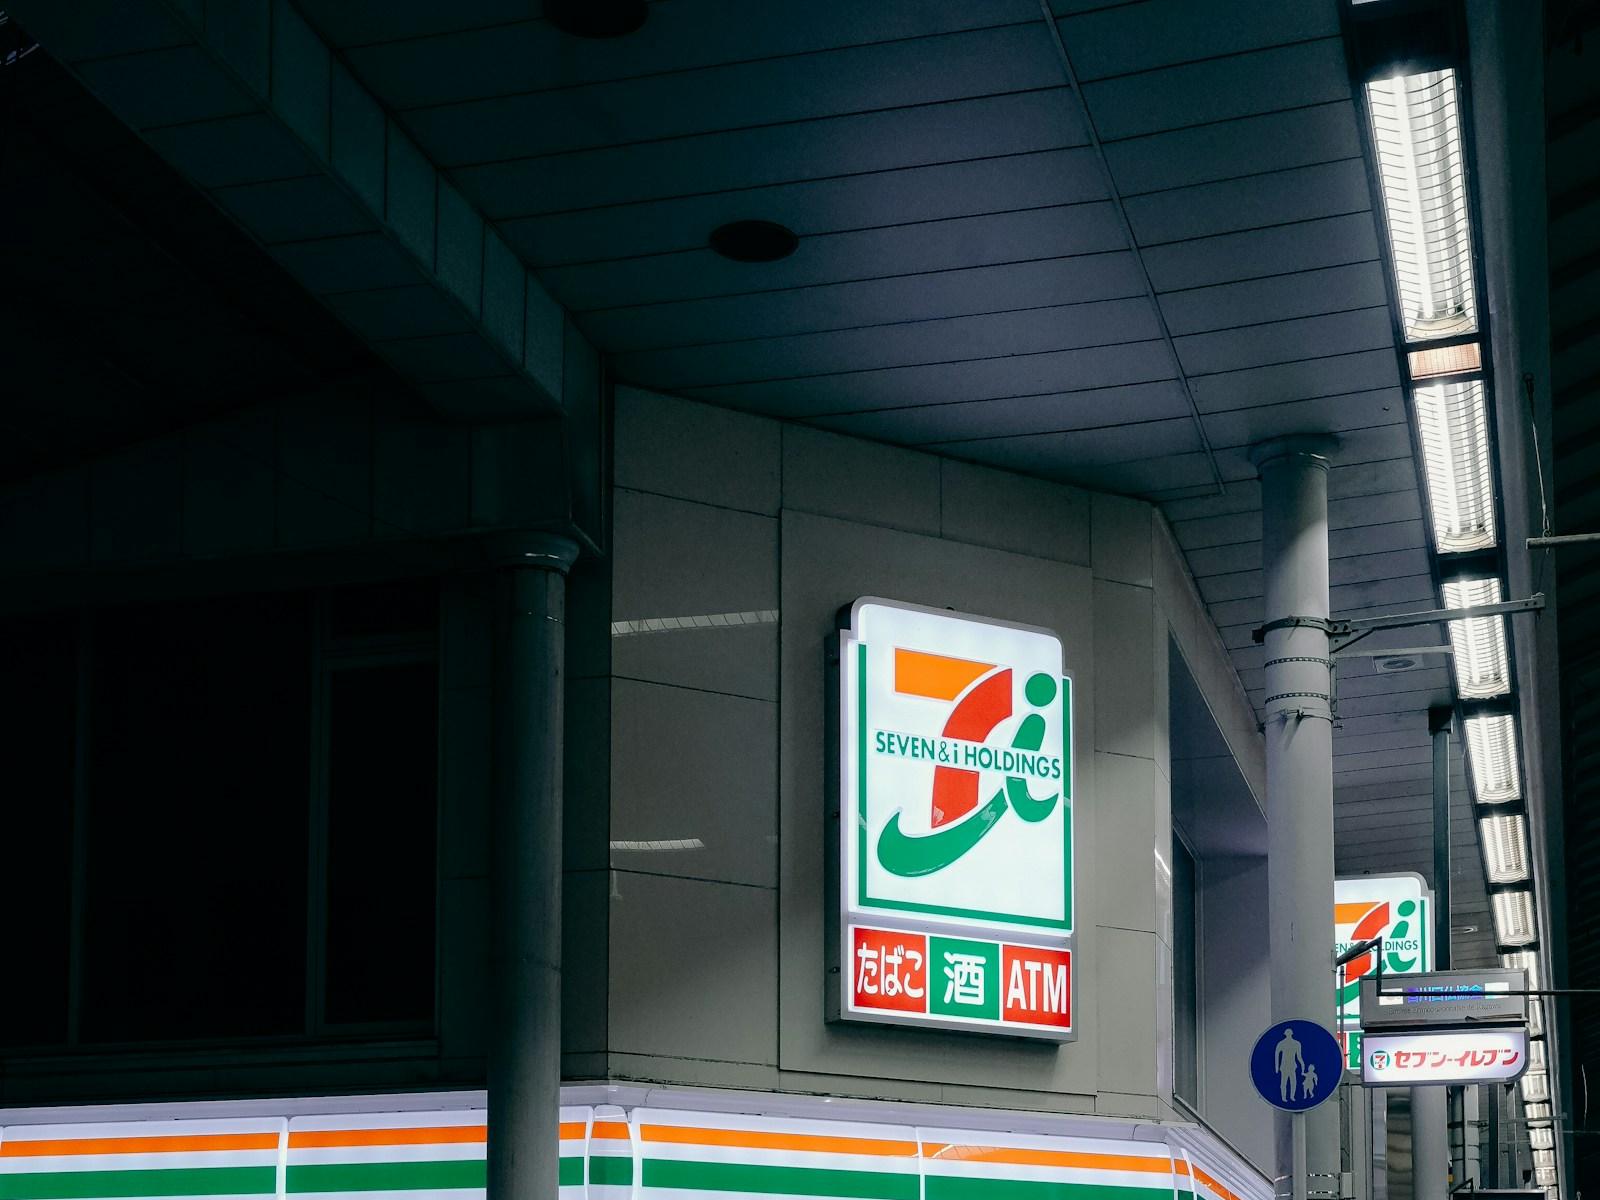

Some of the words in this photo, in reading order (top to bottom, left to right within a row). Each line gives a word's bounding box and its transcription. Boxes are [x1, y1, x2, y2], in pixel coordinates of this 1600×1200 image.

[965, 747, 1060, 779] HOLDINGS
[857, 943, 924, 998] たばこ
[943, 951, 986, 1006] 酒
[1006, 959, 1067, 1015] ATM
